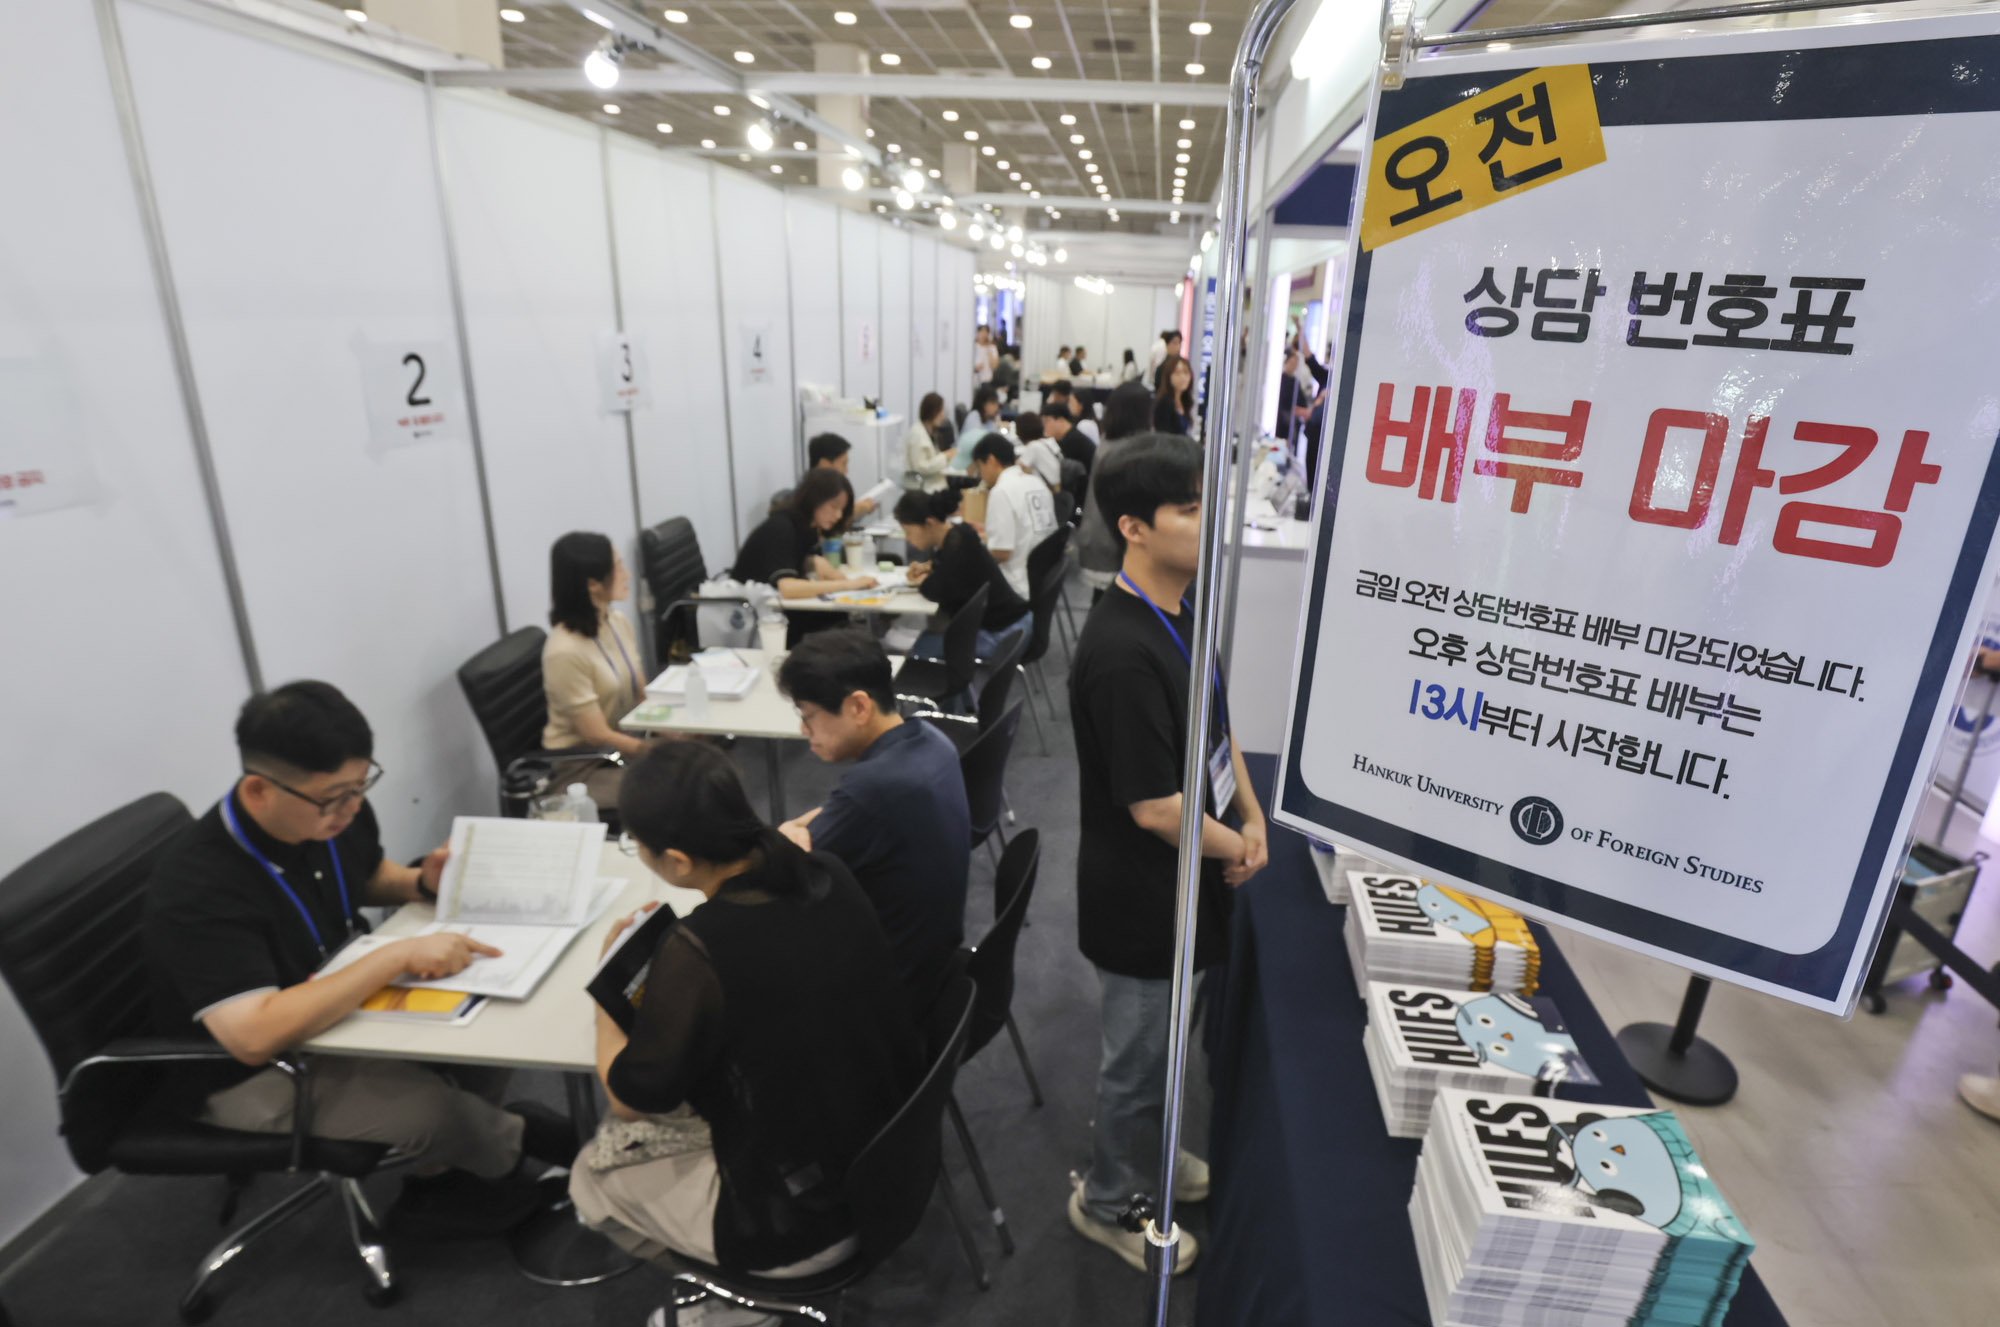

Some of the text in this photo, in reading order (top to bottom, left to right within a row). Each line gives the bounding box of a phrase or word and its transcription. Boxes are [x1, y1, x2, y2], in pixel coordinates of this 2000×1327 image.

[1385, 81, 1563, 227] 오전
[620, 343, 633, 382] 3
[1463, 266, 1866, 356] 상담 번호표
[402, 352, 431, 406] 2
[1365, 382, 1942, 567] 배부 마감
[1356, 569, 1865, 702] 금일 오전 상담번호표 배부 마감되었습니다.
[1409, 627, 1762, 737] 오후 상담번호표 배부는
[1409, 678, 1730, 800] 13시부터 시작합니다.
[1352, 753, 1764, 894] HANKUK UNIVERSITY OF FOREIGN STUDIES
[1363, 877, 1437, 937] HUFS
[1388, 990, 1481, 1068] HUFS
